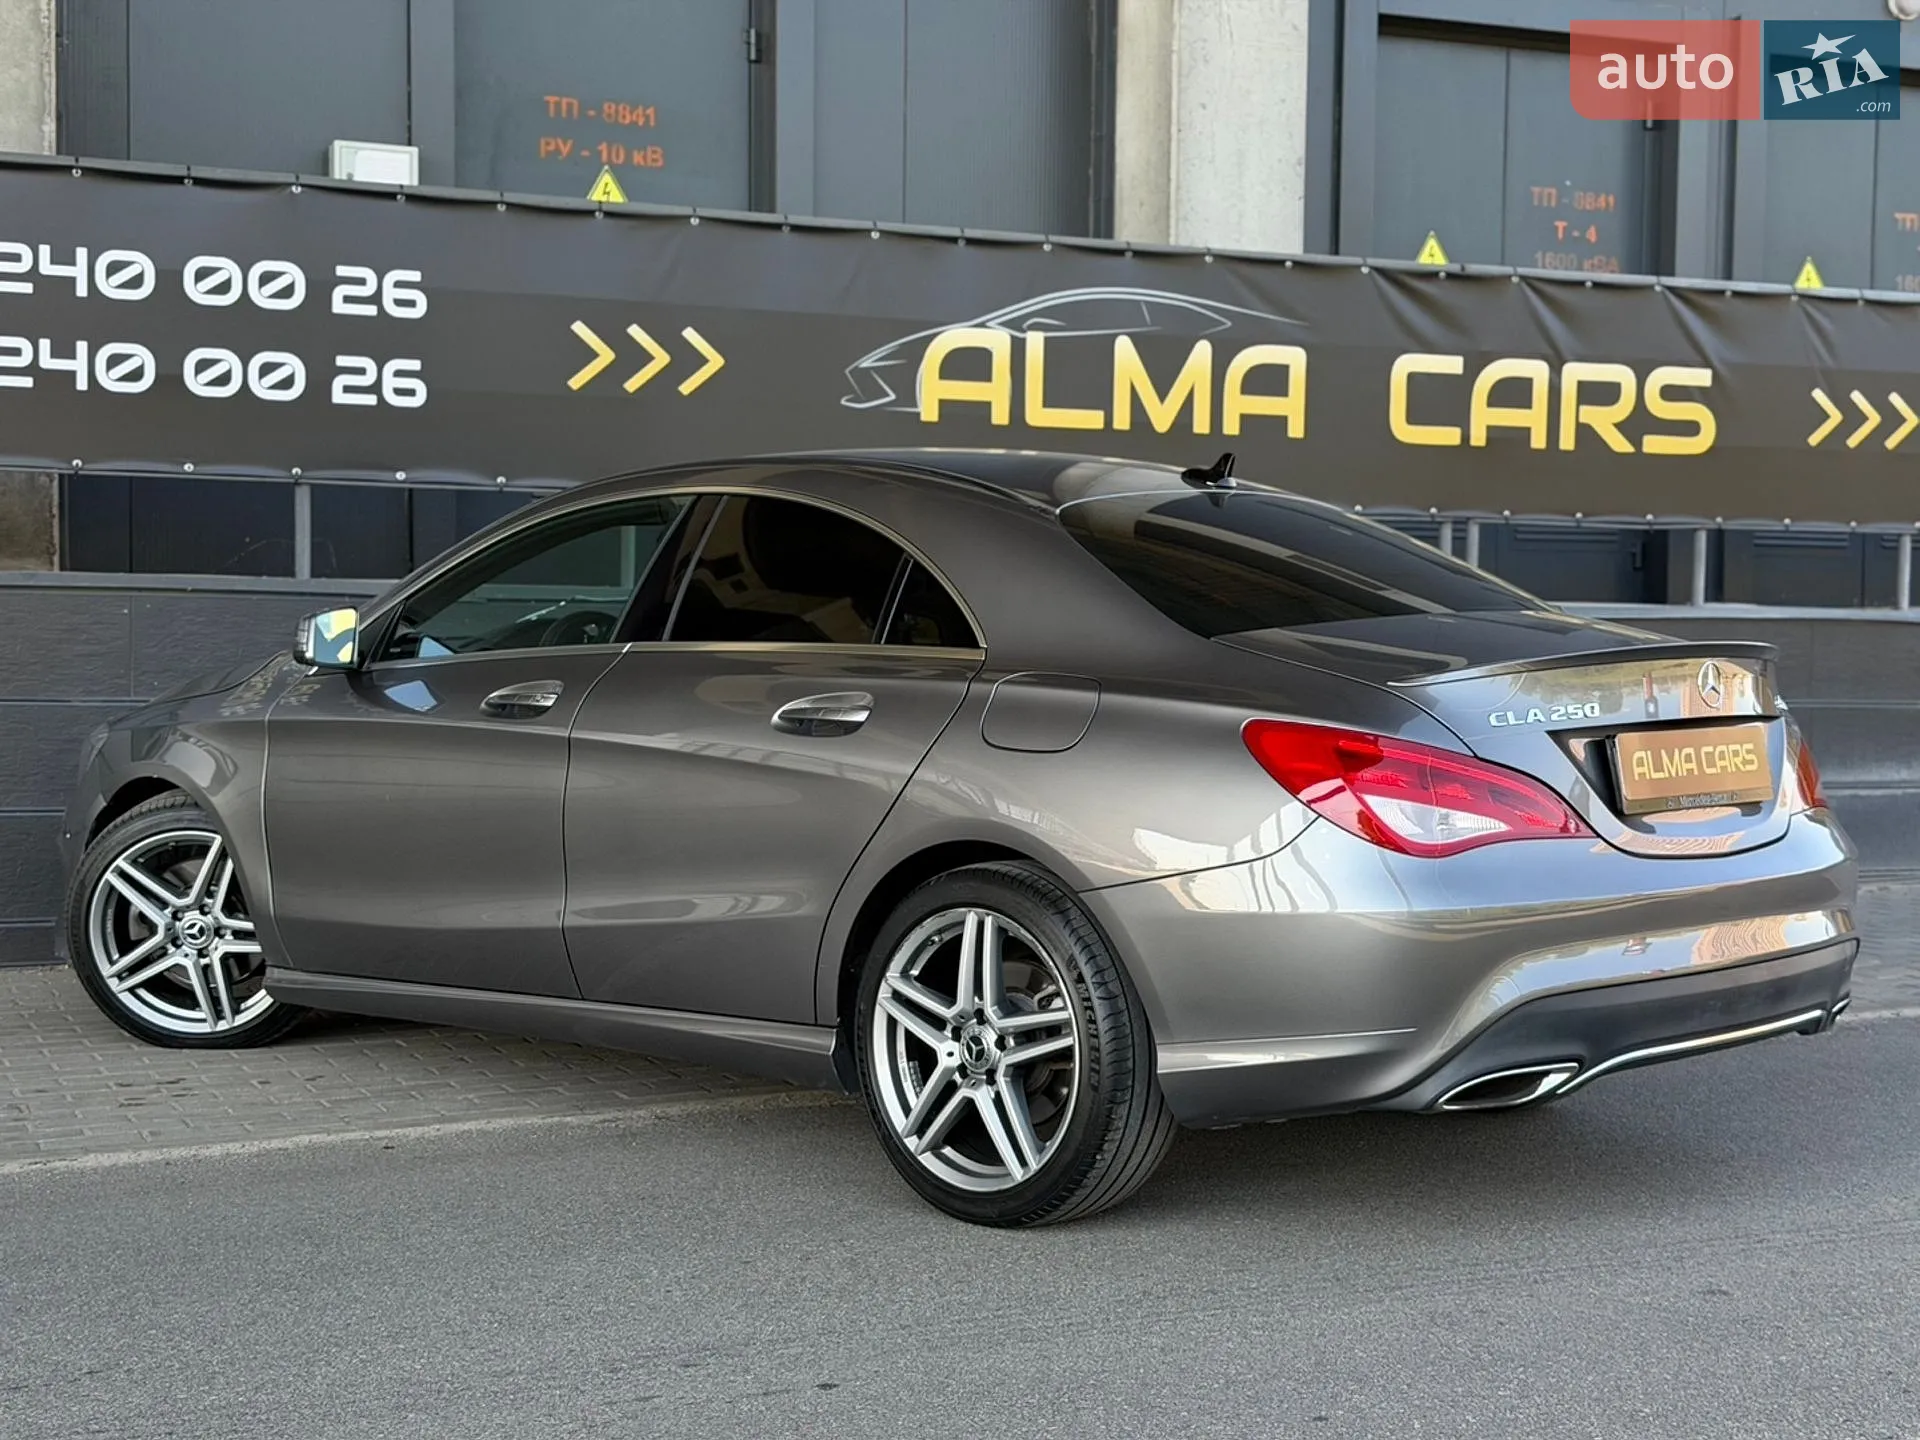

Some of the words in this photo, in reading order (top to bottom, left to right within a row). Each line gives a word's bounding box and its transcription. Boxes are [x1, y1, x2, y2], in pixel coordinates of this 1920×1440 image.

[544, 95, 580, 119] ТП
[602, 100, 656, 128] 8841
[539, 136, 574, 159] РУ
[597, 141, 626, 165] 10
[0, 241, 156, 301] 240
[183, 255, 306, 310] 00
[331, 265, 428, 319] 26
[0, 335, 156, 394] 240
[183, 347, 306, 402] 00
[331, 355, 428, 408] 26
[920, 327, 1307, 439] ALMA
[1389, 353, 1717, 455] CARS
[1488, 707, 1547, 727] CLA
[1549, 702, 1600, 722] 250
[1632, 747, 1699, 781] ALMA
[1701, 743, 1759, 775] CARS
